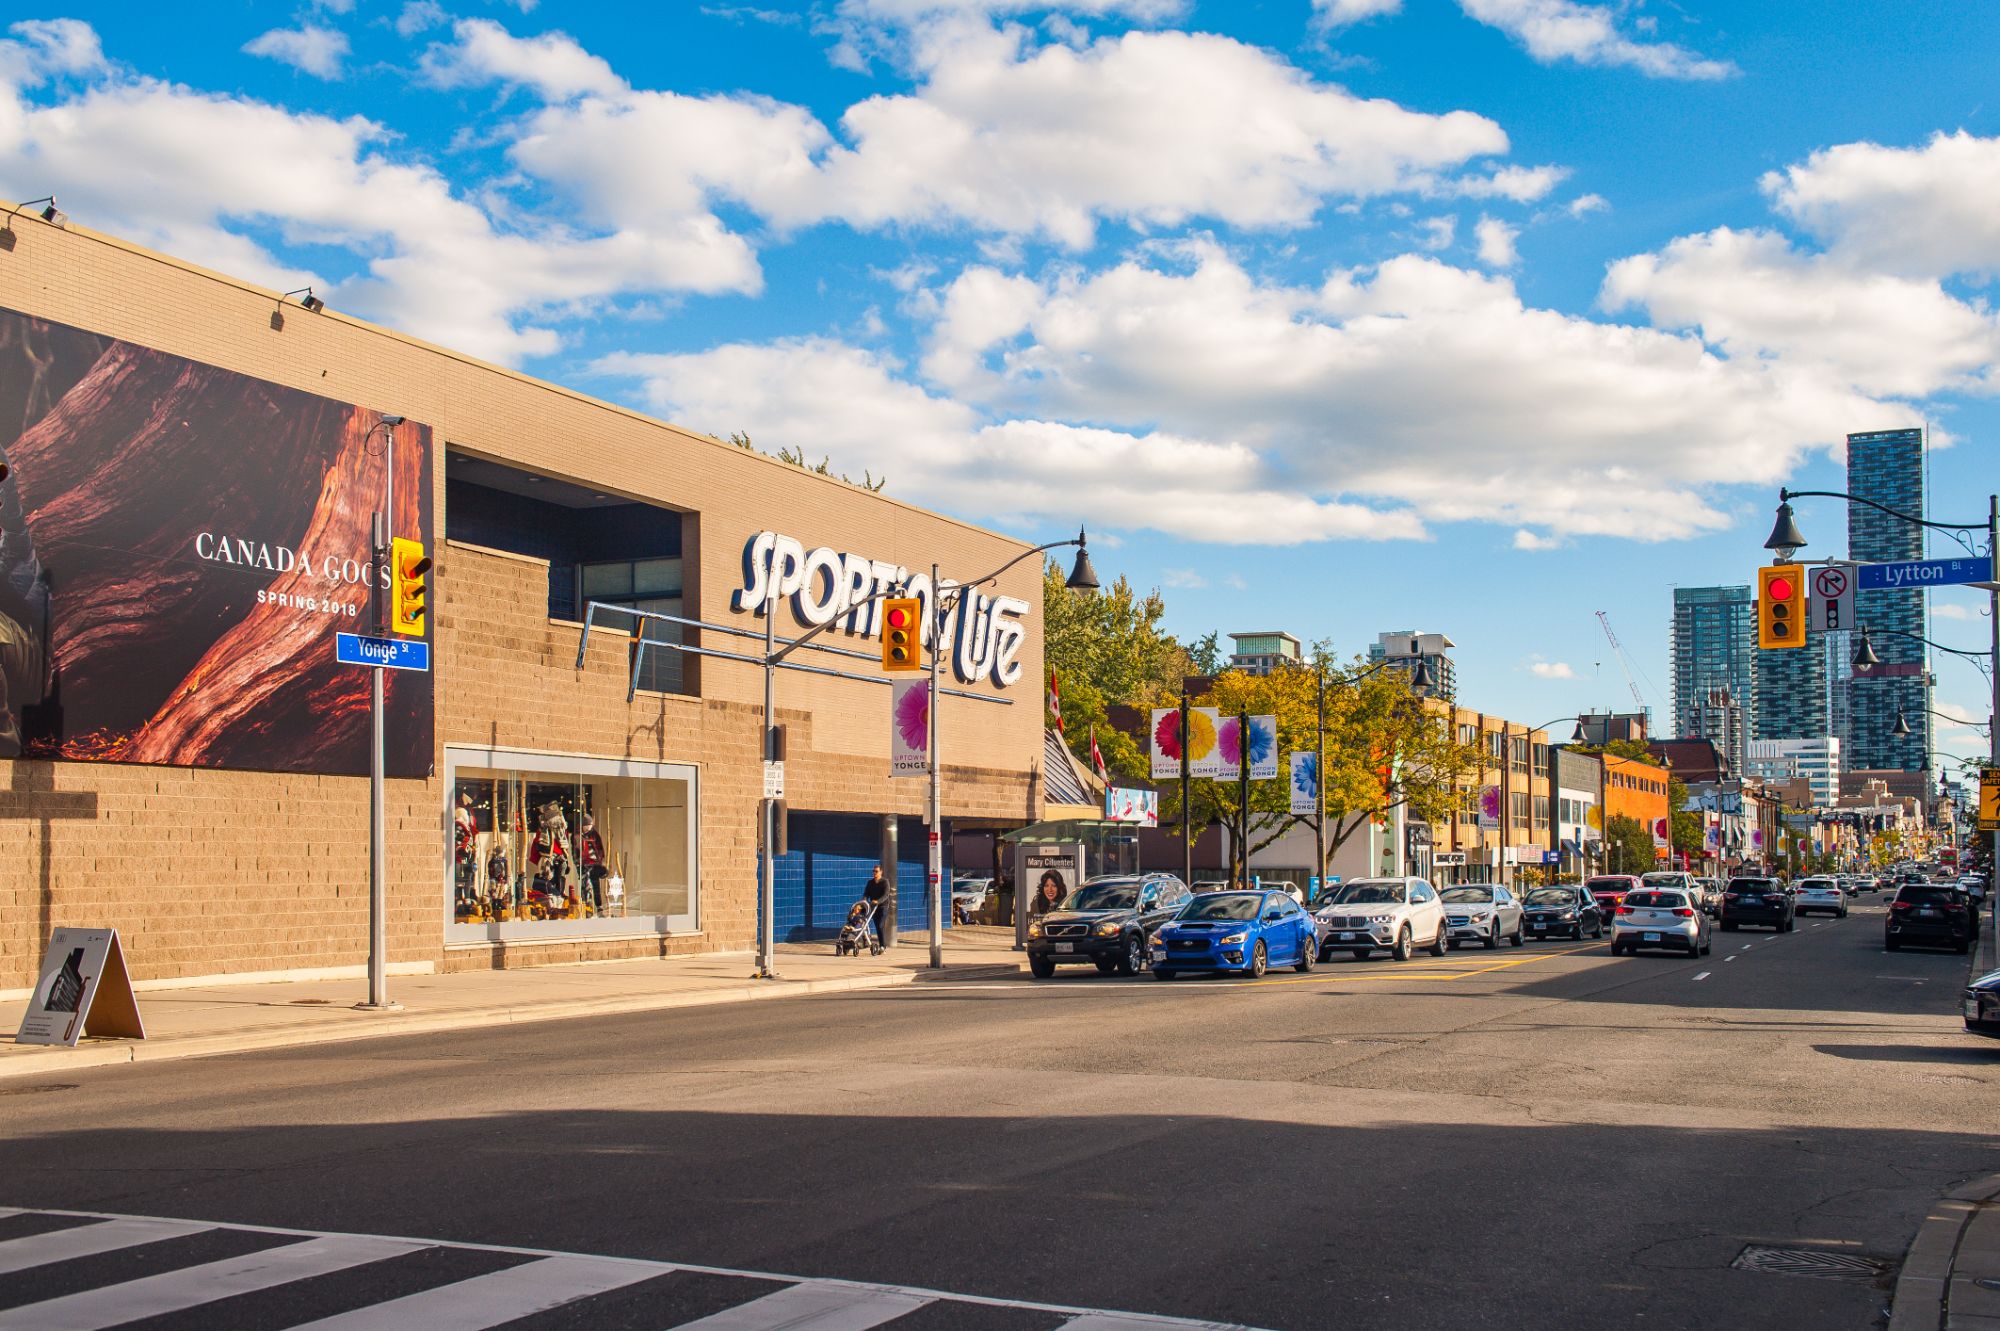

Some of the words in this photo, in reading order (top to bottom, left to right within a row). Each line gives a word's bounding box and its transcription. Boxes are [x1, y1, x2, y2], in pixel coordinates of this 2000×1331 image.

[195, 532, 314, 577] CANADA
[323, 555, 392, 590] GOOS
[1885, 564, 1944, 586] Lytton
[1951, 561, 1962, 570] Bl
[257, 589, 316, 611] SPRING
[321, 599, 356, 617] 2018
[357, 638, 398, 664] Yonge
[401, 643, 409, 653] St
[894, 761, 926, 770] YONGE
[1027, 857, 1043, 868] Mary
